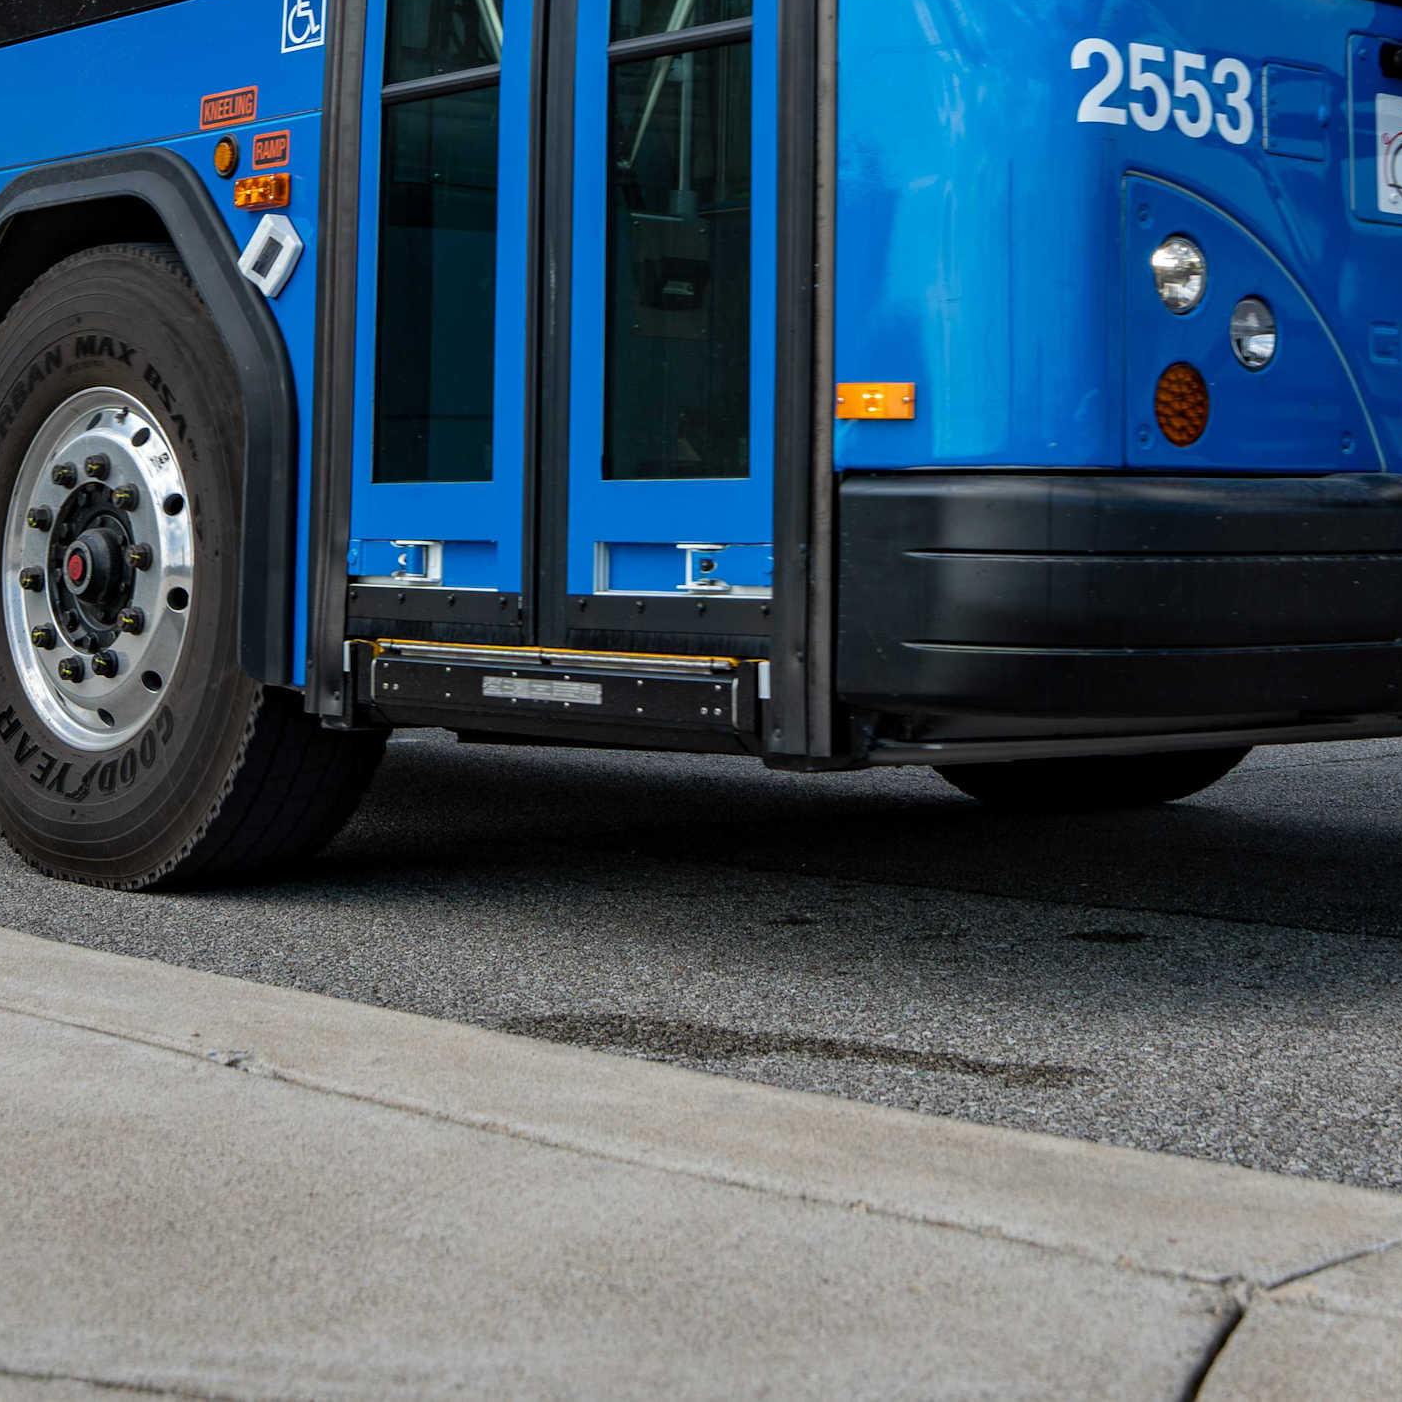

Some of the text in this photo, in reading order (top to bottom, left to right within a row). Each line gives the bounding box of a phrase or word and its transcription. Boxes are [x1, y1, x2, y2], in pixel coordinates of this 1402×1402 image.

[1071, 37, 1253, 145] 2553
[204, 93, 254, 123] KNEELING
[255, 138, 287, 162] RAMP
[74, 334, 139, 367] MAX
